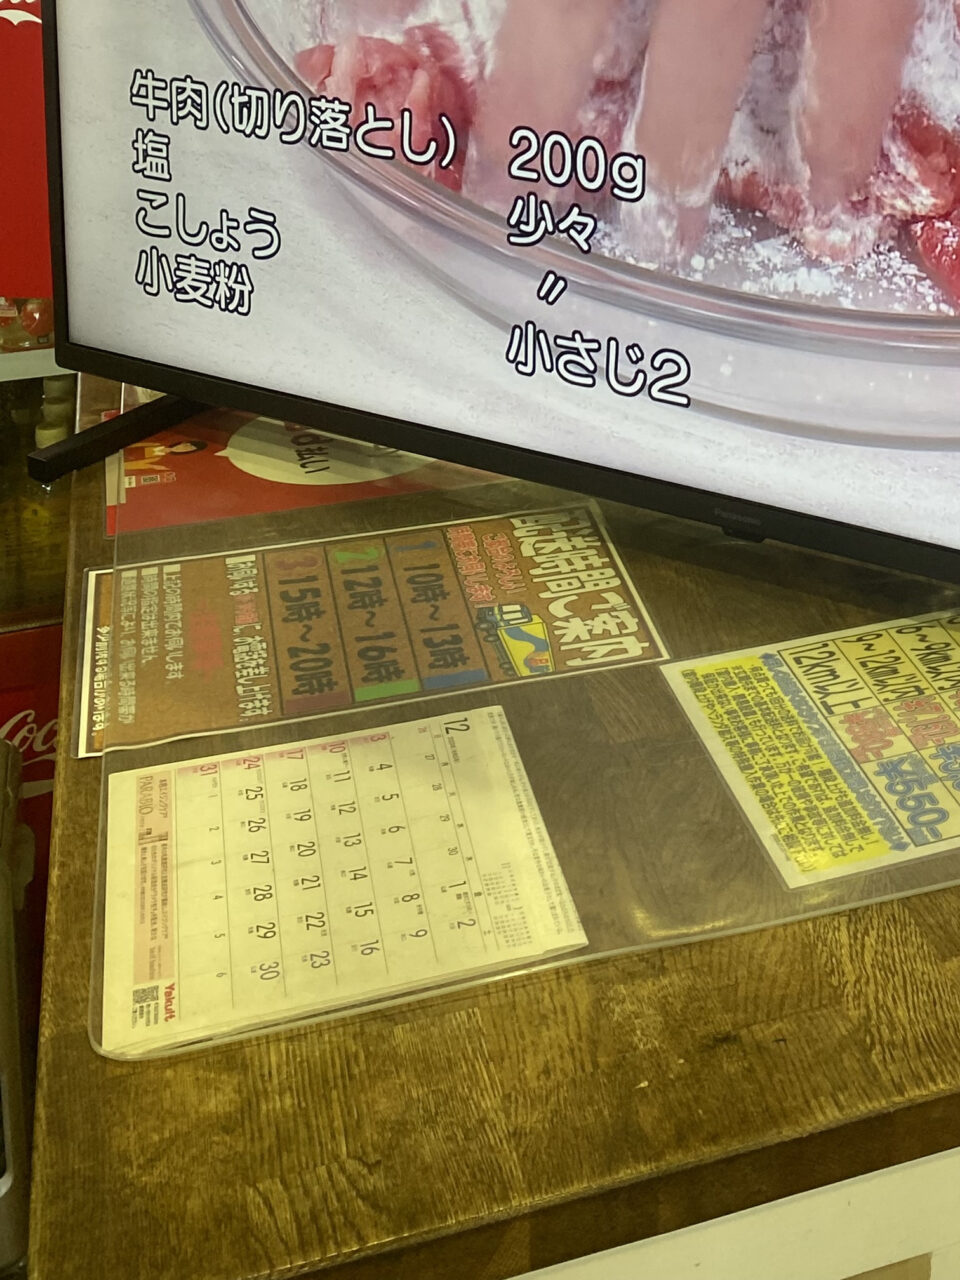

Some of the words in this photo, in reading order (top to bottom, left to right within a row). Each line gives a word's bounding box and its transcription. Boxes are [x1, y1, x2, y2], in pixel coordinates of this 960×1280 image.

[130, 69, 458, 169] 牛肉(切り落とし)
[508, 126, 646, 201] 200g
[132, 129, 172, 183] 塩
[507, 193, 599, 254] 少々
[134, 189, 281, 260] こしょう
[135, 247, 253, 316] 小麦粉
[506, 321, 691, 408] 小さじ2
[509, 508, 652, 668] 配送時間ご案内
[443, 717, 470, 734] 12
[369, 733, 387, 742] 3
[285, 749, 303, 761] 17
[327, 741, 346, 754] 10
[199, 763, 217, 776] 31
[242, 756, 261, 770] 24
[333, 769, 351, 782] 11
[289, 777, 307, 791] 18
[245, 786, 263, 800] 25
[293, 808, 311, 821] 19
[338, 800, 356, 815] 12
[247, 817, 266, 832] 26
[387, 825, 405, 833] 6
[343, 832, 361, 847] 13
[250, 850, 269, 863] 27
[296, 841, 316, 857] 20
[394, 856, 413, 864] 7
[348, 866, 367, 880] 14
[300, 874, 320, 890] 21
[448, 880, 466, 888] 1
[253, 884, 273, 901] 28
[401, 893, 420, 902] 8
[353, 901, 374, 917] 15
[305, 911, 325, 930] 22
[456, 918, 476, 929] 2
[255, 921, 276, 938] 29
[408, 928, 427, 937] 9
[360, 939, 379, 955] 16
[309, 950, 330, 968] 23
[259, 961, 280, 980] 30
[163, 982, 176, 1023] Yakult
